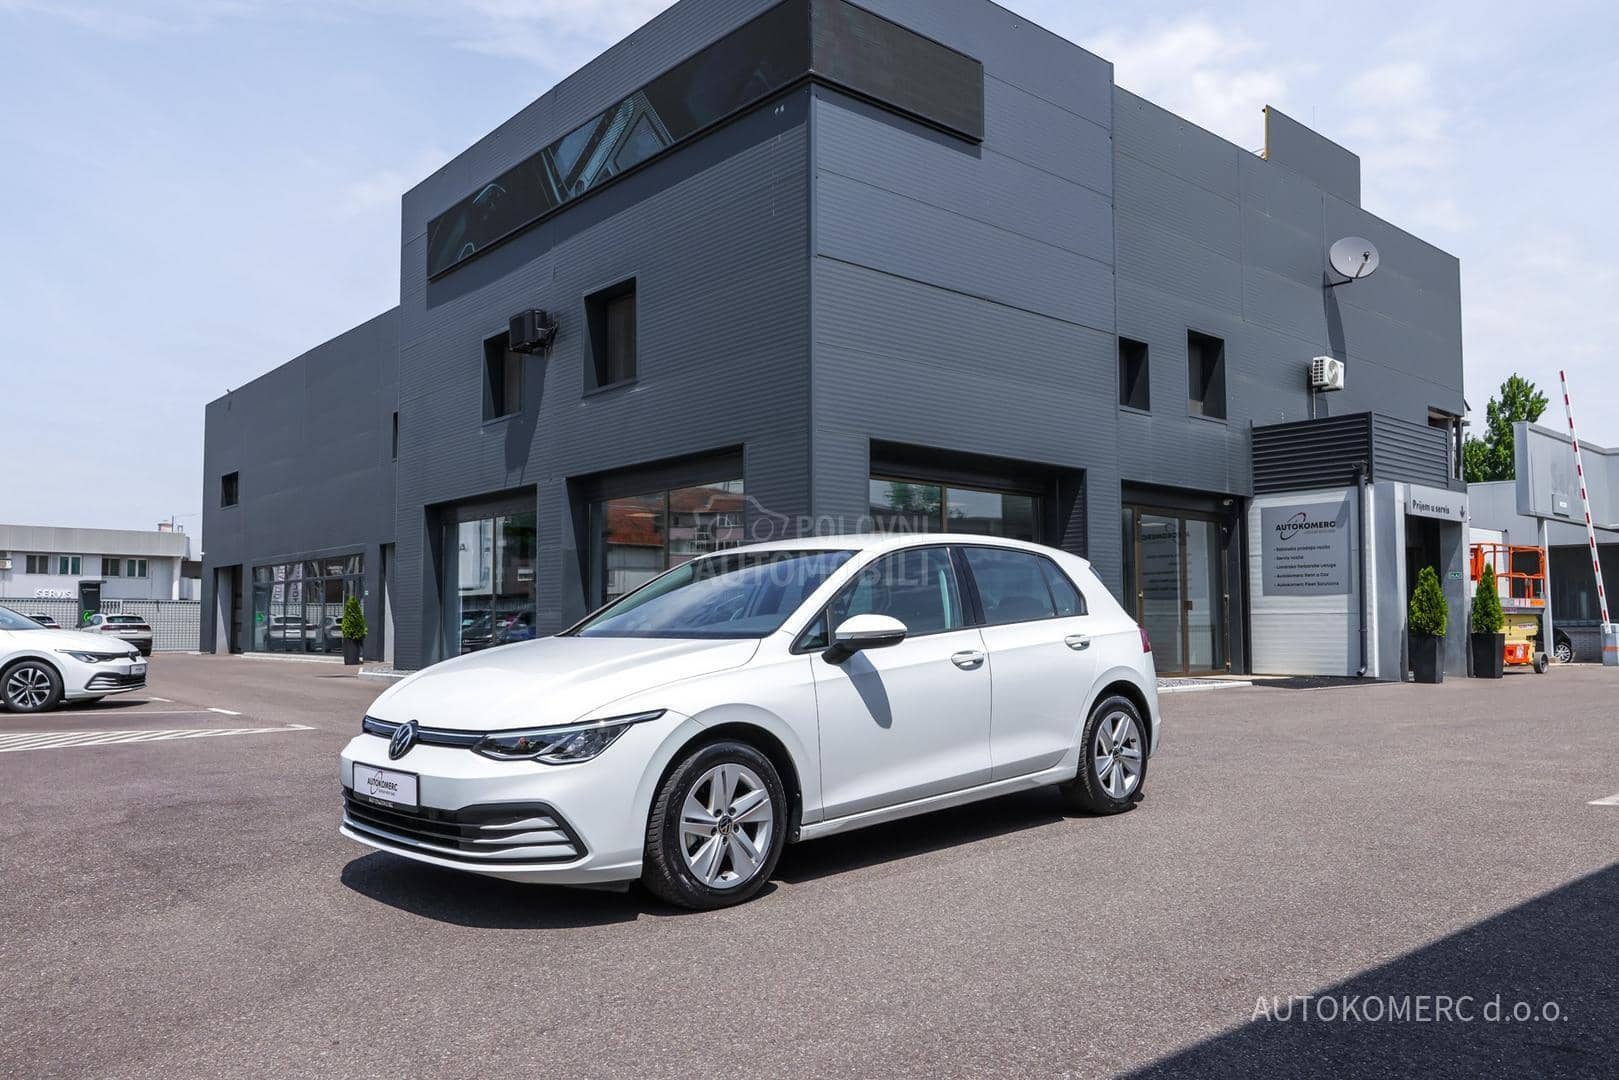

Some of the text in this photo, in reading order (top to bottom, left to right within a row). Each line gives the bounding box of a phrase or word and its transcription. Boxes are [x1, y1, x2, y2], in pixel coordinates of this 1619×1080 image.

[1412, 499, 1430, 512] Prijem
[1436, 505, 1450, 514] servis
[1275, 520, 1336, 531] AUTOKOMERC
[36, 589, 72, 598] SERVIS
[367, 777, 398, 792] AUTOKOMERC
